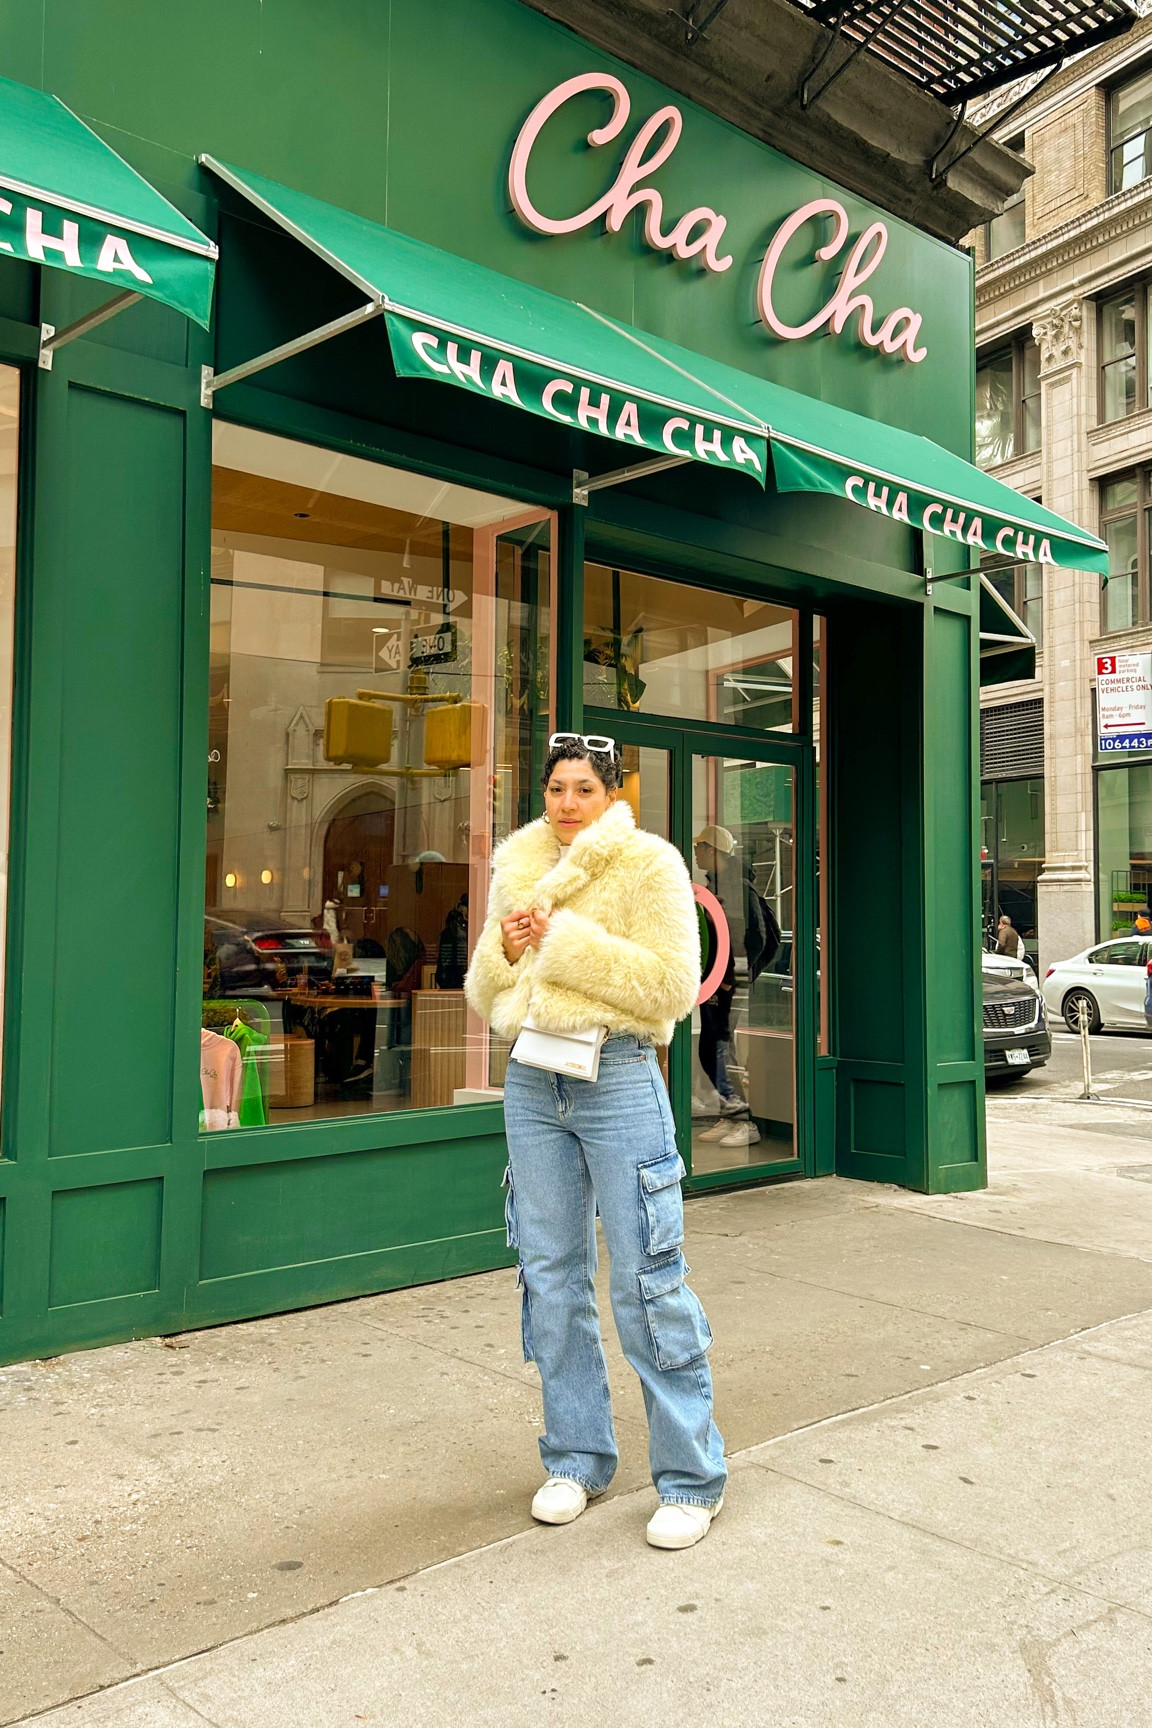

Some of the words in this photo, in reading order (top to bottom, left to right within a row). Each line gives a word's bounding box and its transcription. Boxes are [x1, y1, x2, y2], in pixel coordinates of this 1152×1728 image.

[508, 72, 733, 273] Cha
[757, 198, 928, 363] Cha
[411, 331, 526, 408] CHA
[542, 378, 648, 445] CHA
[662, 417, 763, 473] CHA
[844, 475, 912, 524] CHA
[922, 503, 988, 550] CHA
[995, 526, 1060, 567] CHA
[1101, 658, 1112, 674] 3
[1100, 676, 1147, 686] COMMERCIAL
[1100, 685, 1135, 694] VEHICLES
[1101, 705, 1123, 713] Monday
[1128, 703, 1147, 711] Friday
